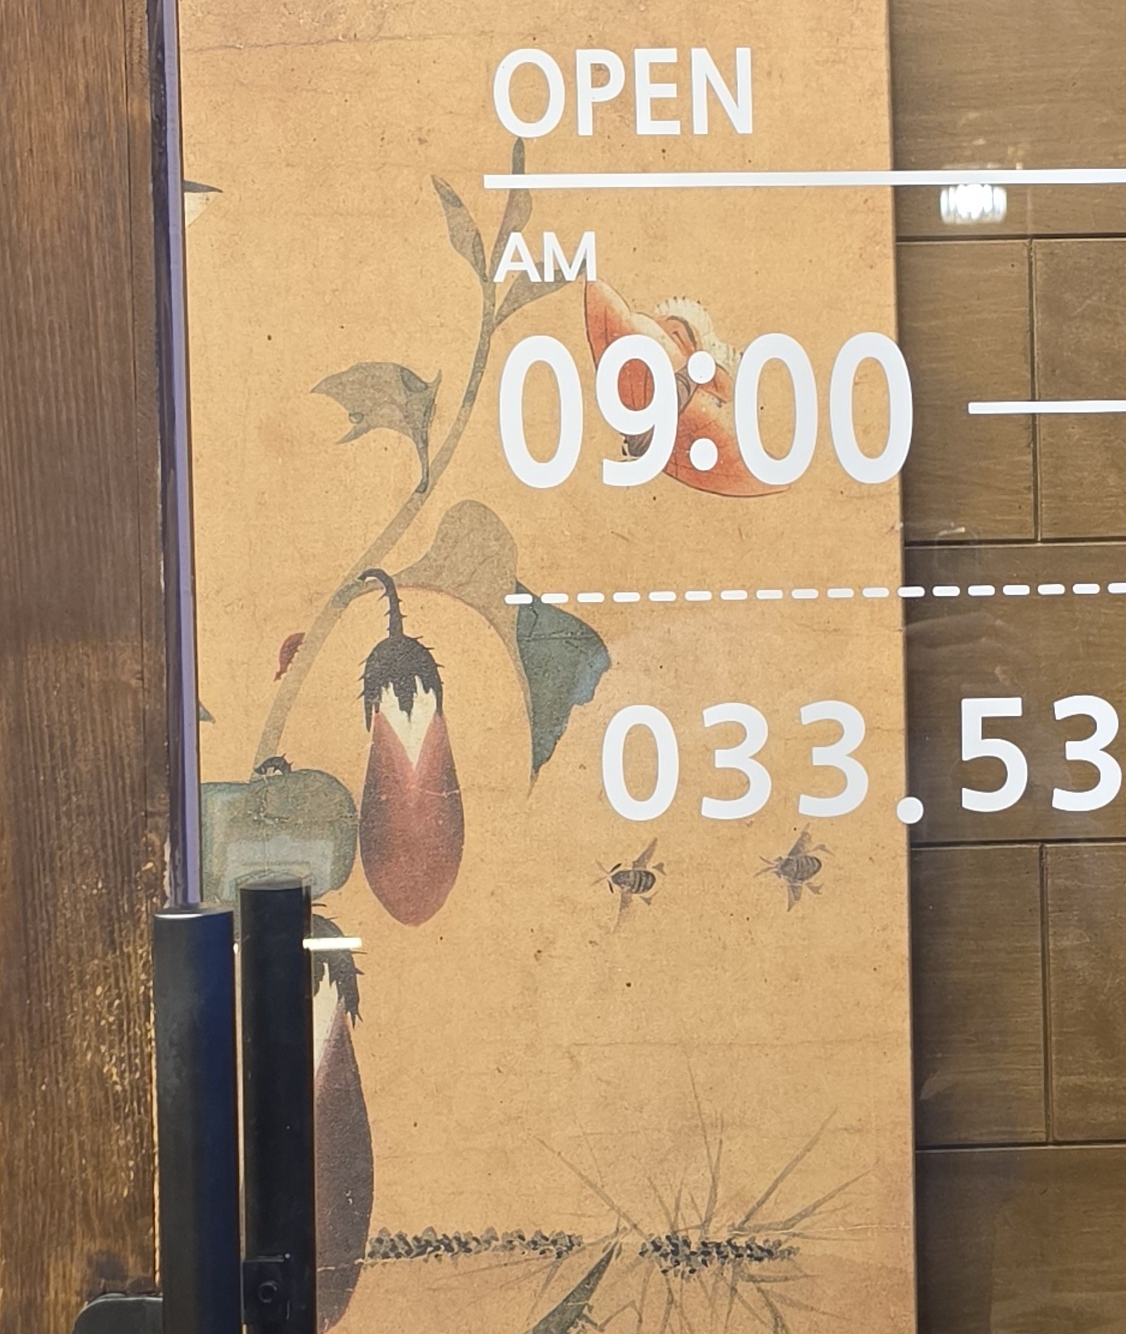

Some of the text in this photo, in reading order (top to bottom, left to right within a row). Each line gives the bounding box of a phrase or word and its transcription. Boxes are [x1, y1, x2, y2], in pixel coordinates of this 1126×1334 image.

[492, 47, 753, 139] OPEN
[493, 231, 597, 283] AM
[499, 332, 912, 488] 09:00
